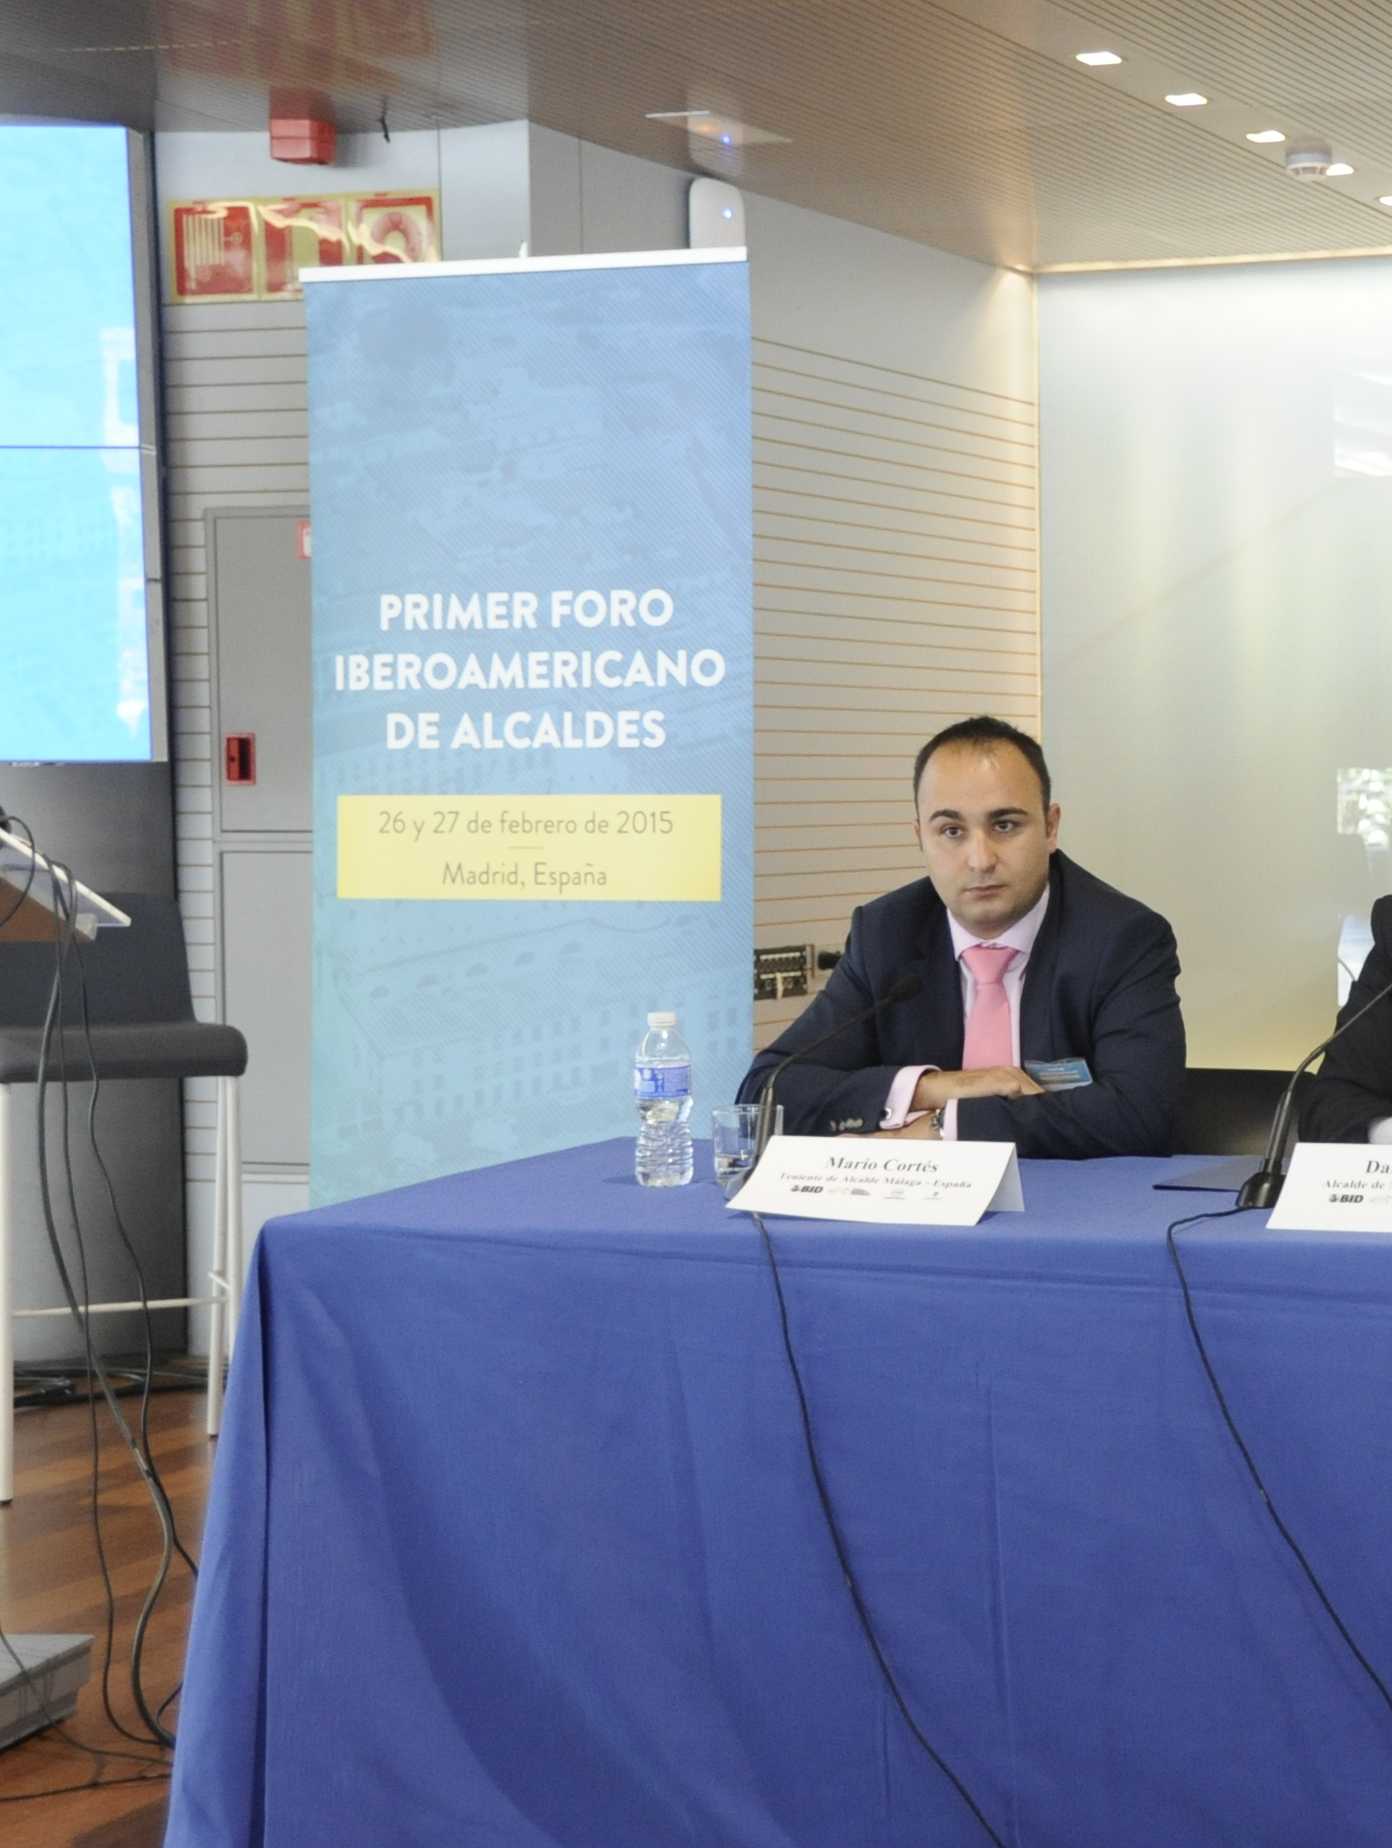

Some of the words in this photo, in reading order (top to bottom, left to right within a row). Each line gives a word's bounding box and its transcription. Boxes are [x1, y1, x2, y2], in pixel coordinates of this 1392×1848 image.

[380, 591, 538, 631] PRIMER
[551, 589, 674, 628] FORO
[335, 649, 727, 691] IBEROAMERICANO
[386, 712, 440, 750] DE
[451, 710, 667, 750] ALCALDES
[378, 810, 406, 835] 26
[412, 819, 426, 843] y
[432, 810, 460, 835] 27
[466, 810, 493, 835] de
[500, 810, 577, 835] febrero
[584, 810, 609, 835] de
[616, 810, 674, 835] 2015
[441, 861, 525, 890] Madrid,
[533, 861, 608, 895] España
[827, 1156, 878, 1170] Mario
[883, 1158, 938, 1173] Cortés
